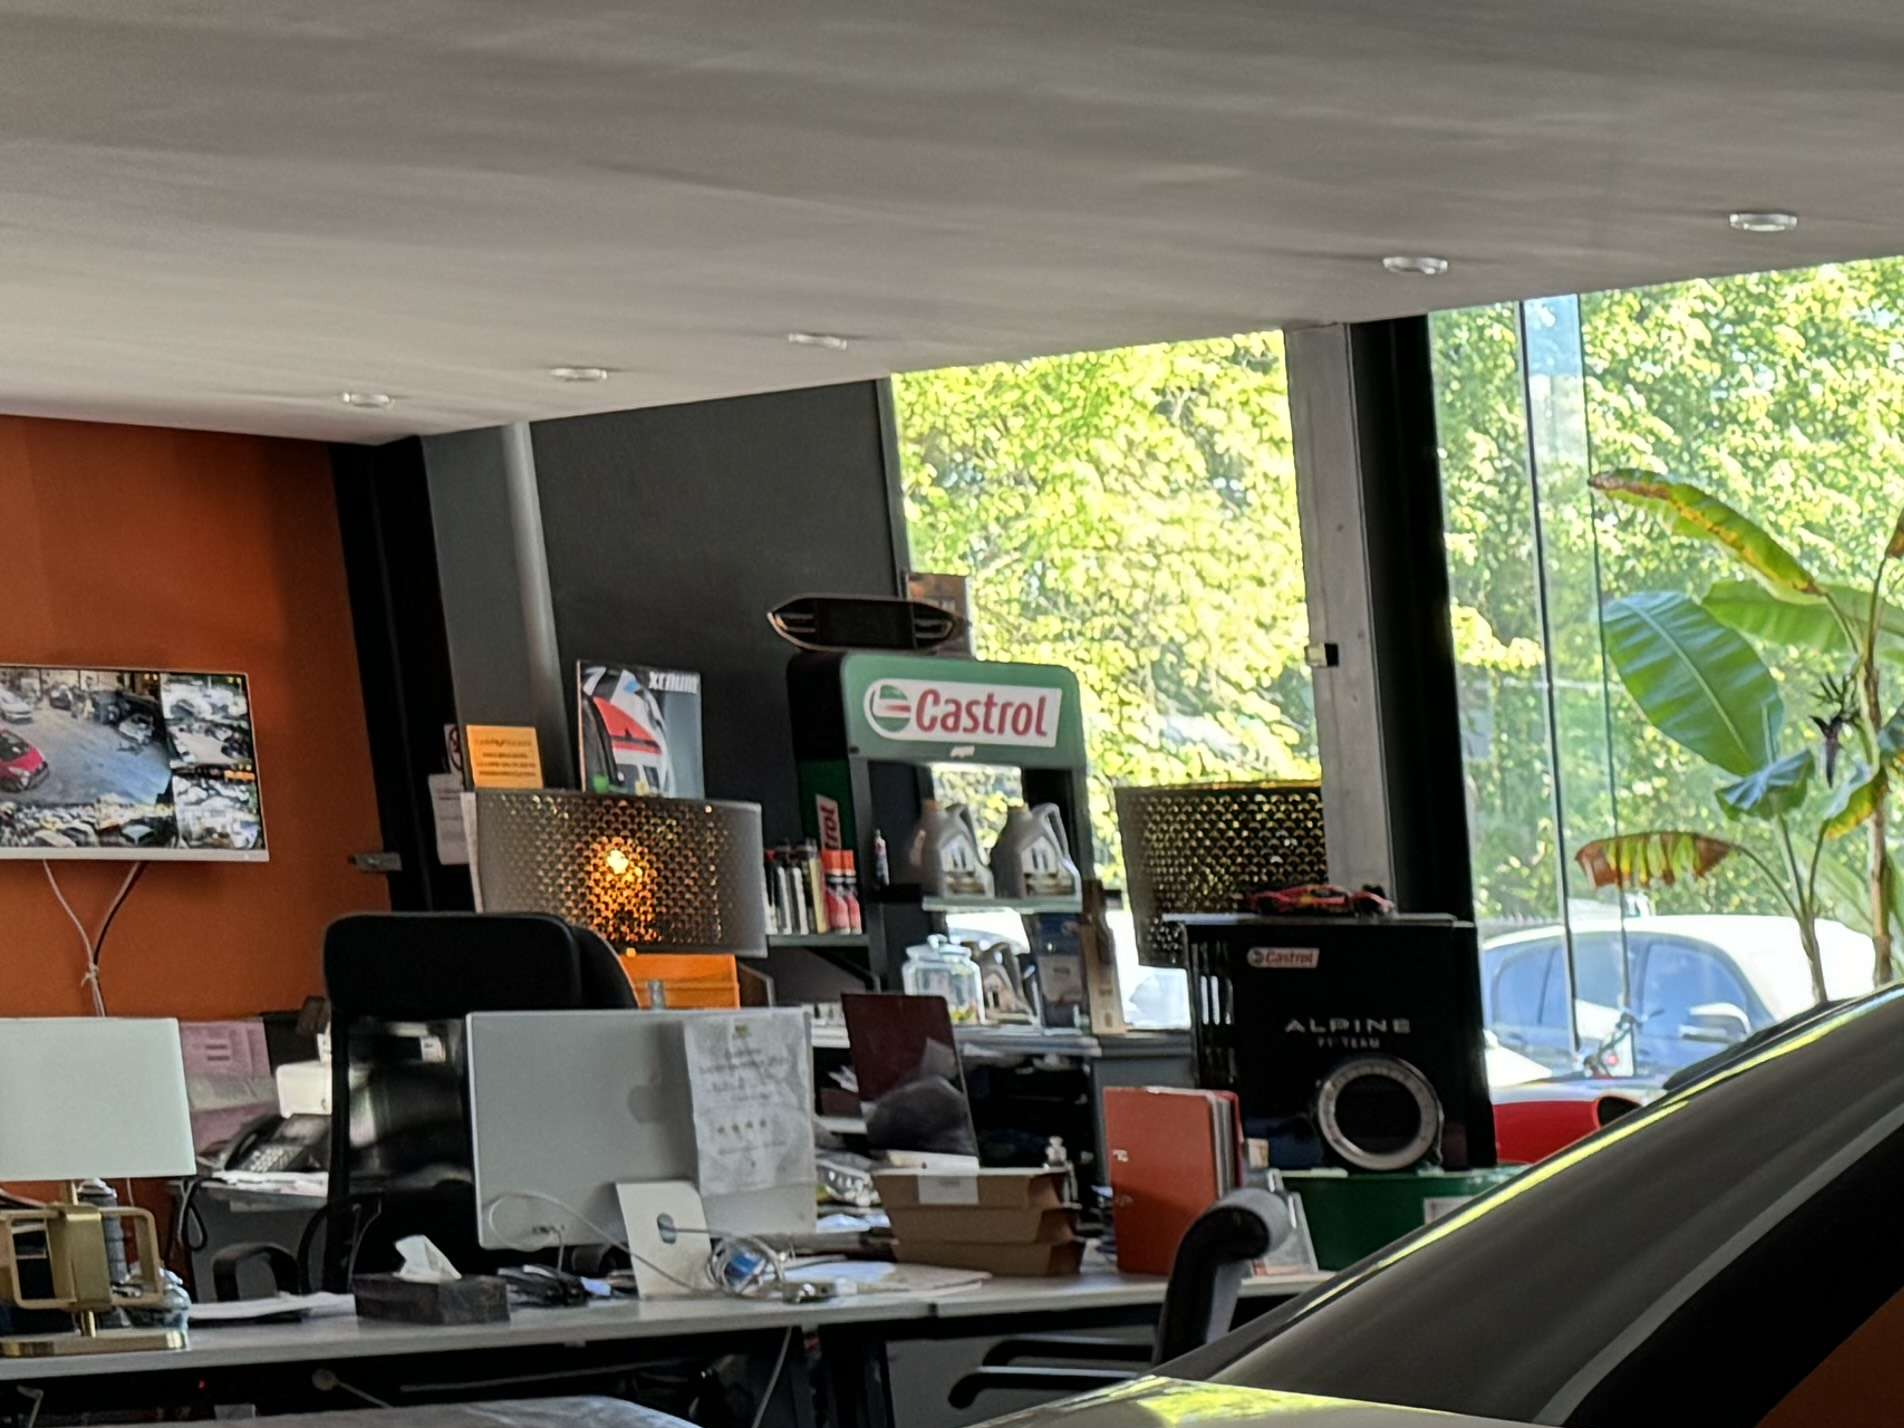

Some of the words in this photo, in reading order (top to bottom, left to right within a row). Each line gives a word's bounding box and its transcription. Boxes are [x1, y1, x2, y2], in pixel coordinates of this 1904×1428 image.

[915, 688, 1048, 737] Castrol
[1263, 952, 1314, 965] Castrol
[1285, 1017, 1411, 1034] ALPINE
